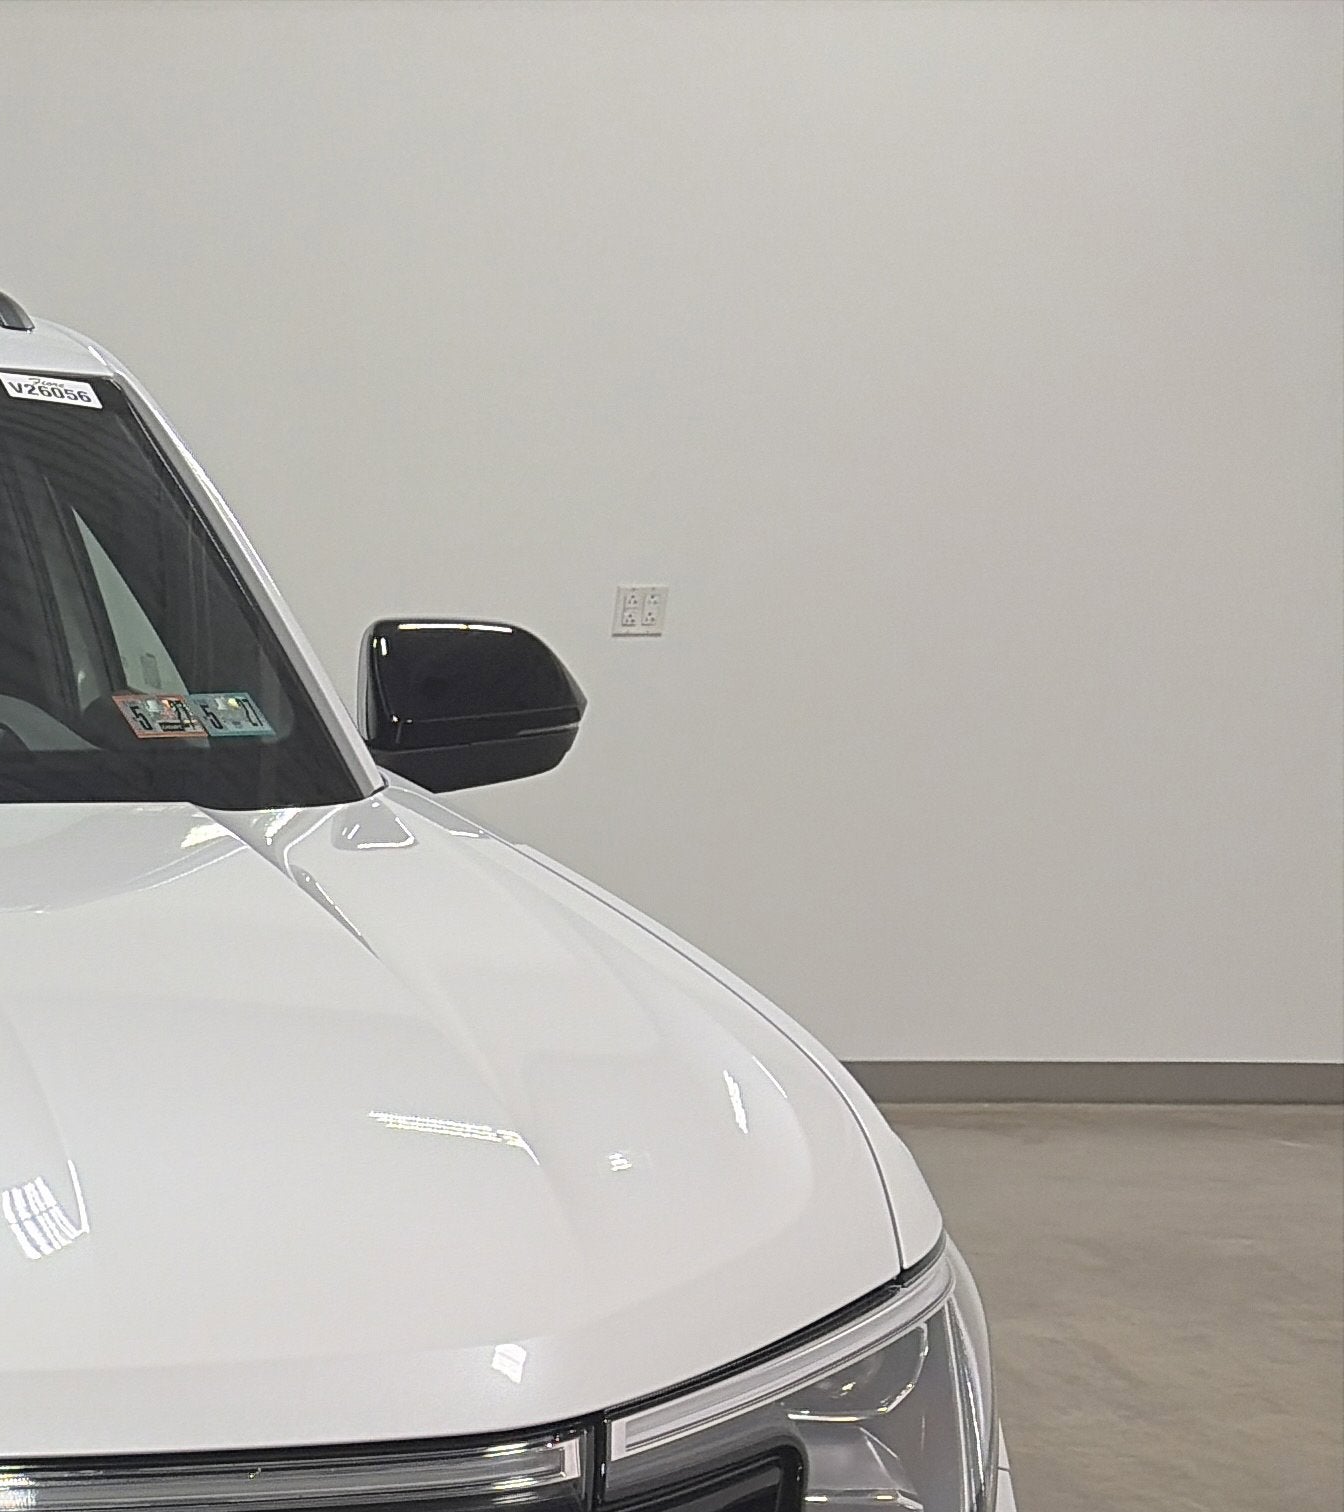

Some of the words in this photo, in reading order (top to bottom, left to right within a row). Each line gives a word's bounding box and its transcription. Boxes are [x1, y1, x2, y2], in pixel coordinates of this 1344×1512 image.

[8, 381, 92, 402] V26056
[130, 706, 153, 730] 5
[200, 704, 223, 729] 5
